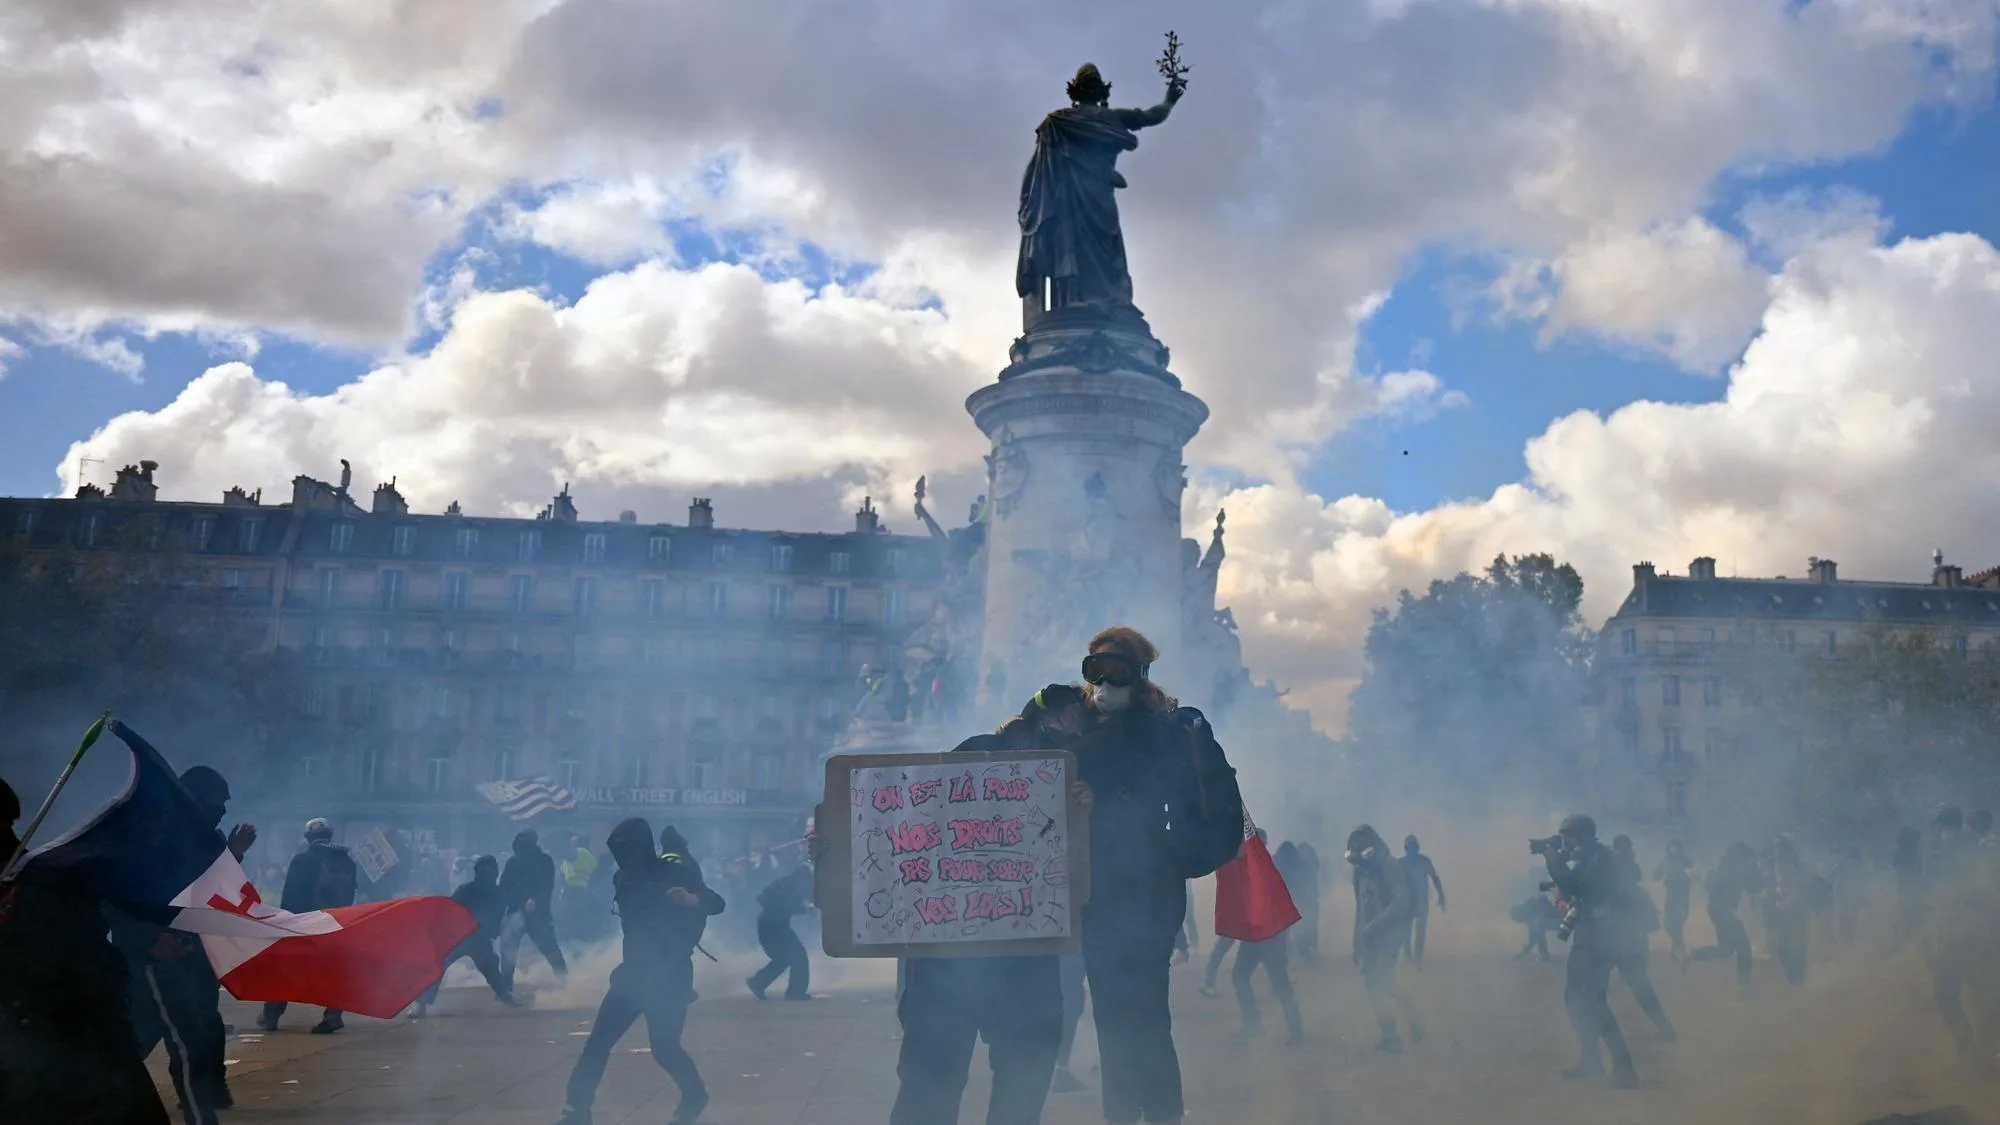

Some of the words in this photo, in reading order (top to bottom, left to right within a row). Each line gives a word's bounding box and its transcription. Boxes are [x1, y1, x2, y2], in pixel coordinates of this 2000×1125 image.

[572, 787, 614, 803] WALL
[681, 788, 747, 804] ENGLISH
[872, 785, 904, 813] ON
[909, 779, 942, 806] EST
[983, 777, 1030, 803] POUR
[886, 821, 942, 855] NOS
[947, 814, 1024, 850] DROITS
[900, 857, 933, 886] PAS
[937, 857, 987, 884] POUR
[913, 894, 959, 926] VOS
[963, 889, 1016, 922] LOIS
